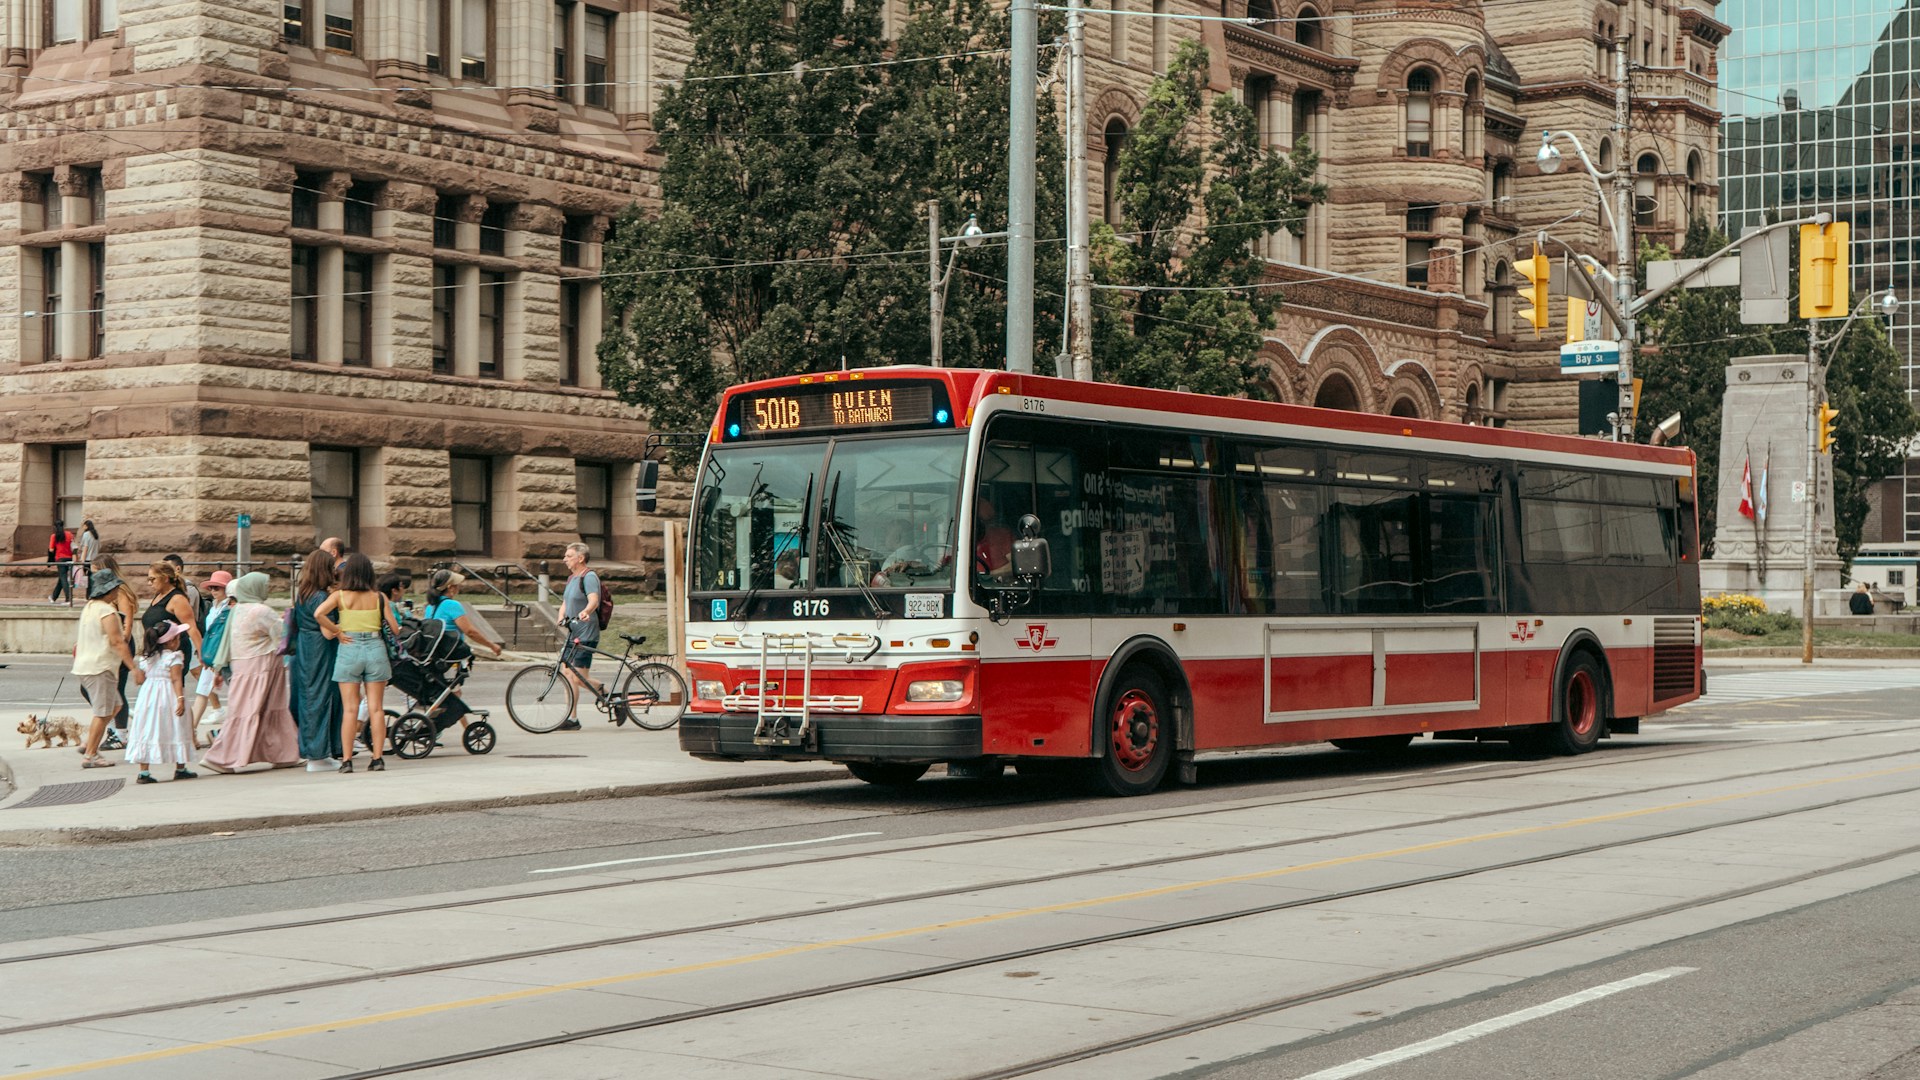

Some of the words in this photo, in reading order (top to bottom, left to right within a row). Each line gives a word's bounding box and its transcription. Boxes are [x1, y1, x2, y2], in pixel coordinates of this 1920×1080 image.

[1575, 354, 1592, 366] Bay
[1595, 354, 1604, 363] St
[832, 389, 892, 410] QUEEN
[1023, 398, 1045, 412] 8176
[755, 397, 800, 430] 501B
[833, 410, 845, 425] TO
[848, 406, 893, 424] BATHURST
[792, 599, 830, 617] 8176
